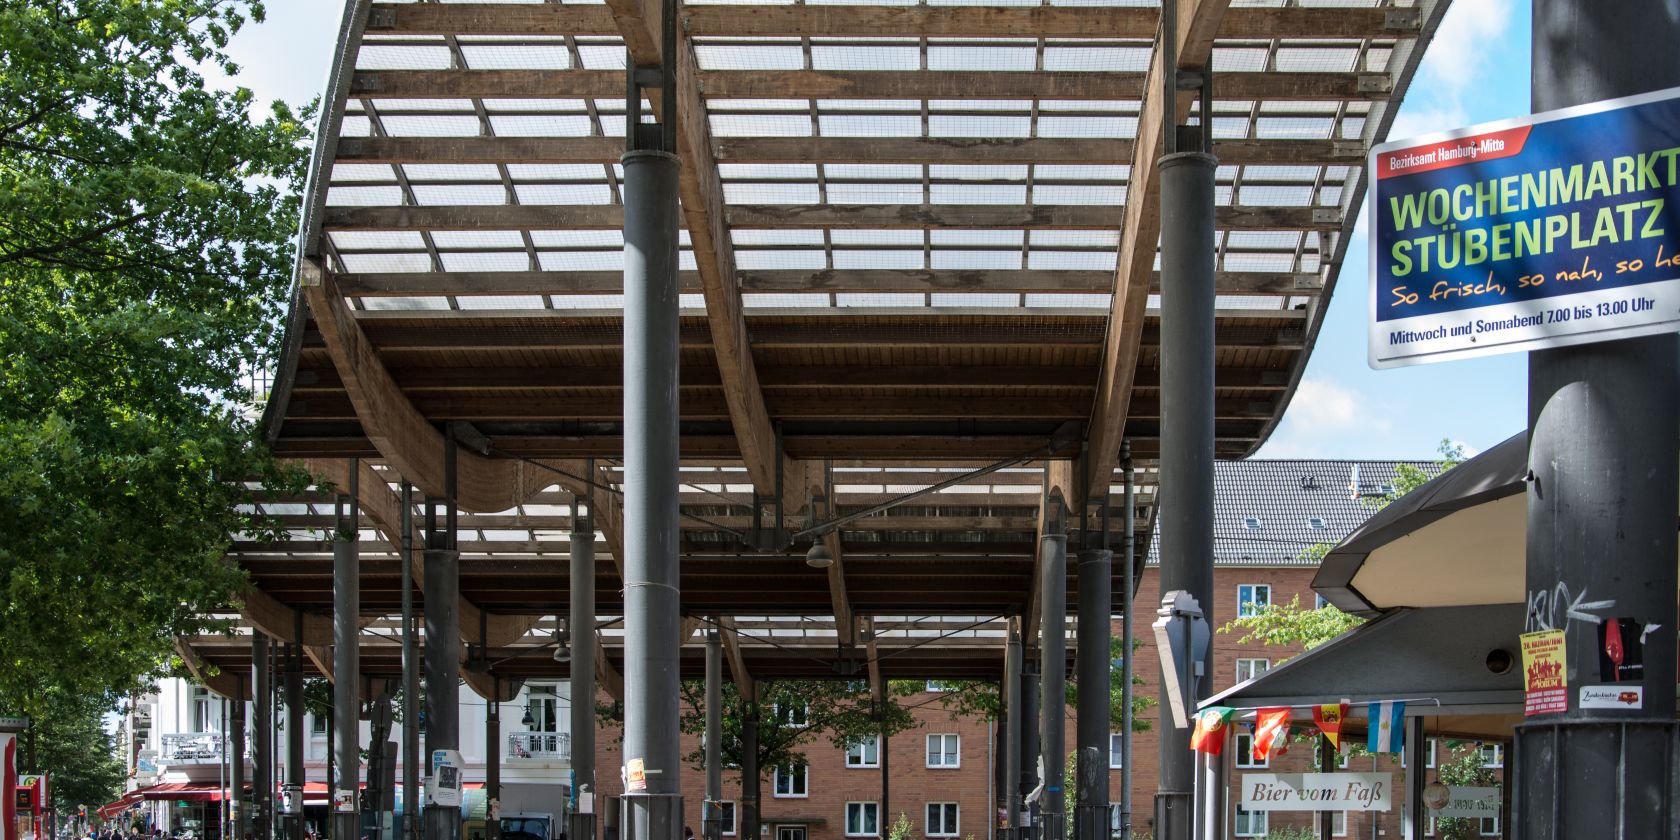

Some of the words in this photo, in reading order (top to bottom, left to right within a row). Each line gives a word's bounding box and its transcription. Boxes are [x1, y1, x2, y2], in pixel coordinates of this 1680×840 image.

[1389, 150, 1437, 171] Bezirksamt
[1437, 138, 1505, 162] Hamburg-Mitte
[1389, 147, 1680, 233] WOCHENMARKT
[1390, 198, 1666, 278] STÜBENPLATZ
[1391, 286, 1418, 307] So
[1429, 271, 1506, 301] frisch,
[1518, 274, 1545, 288] so
[1555, 256, 1603, 282] nah,
[1615, 257, 1643, 275] so
[1389, 324, 1447, 346] Mittwoch
[1450, 320, 1473, 338] und
[1475, 311, 1544, 334] Sonnabend
[1547, 308, 1571, 324] 7.00
[1573, 303, 1593, 320] bis
[1596, 299, 1628, 317] 13.00
[1631, 296, 1656, 312] Uhr
[1251, 781, 1294, 802] Bier
[1296, 787, 1339, 802] vom
[1343, 780, 1383, 809] Faß
